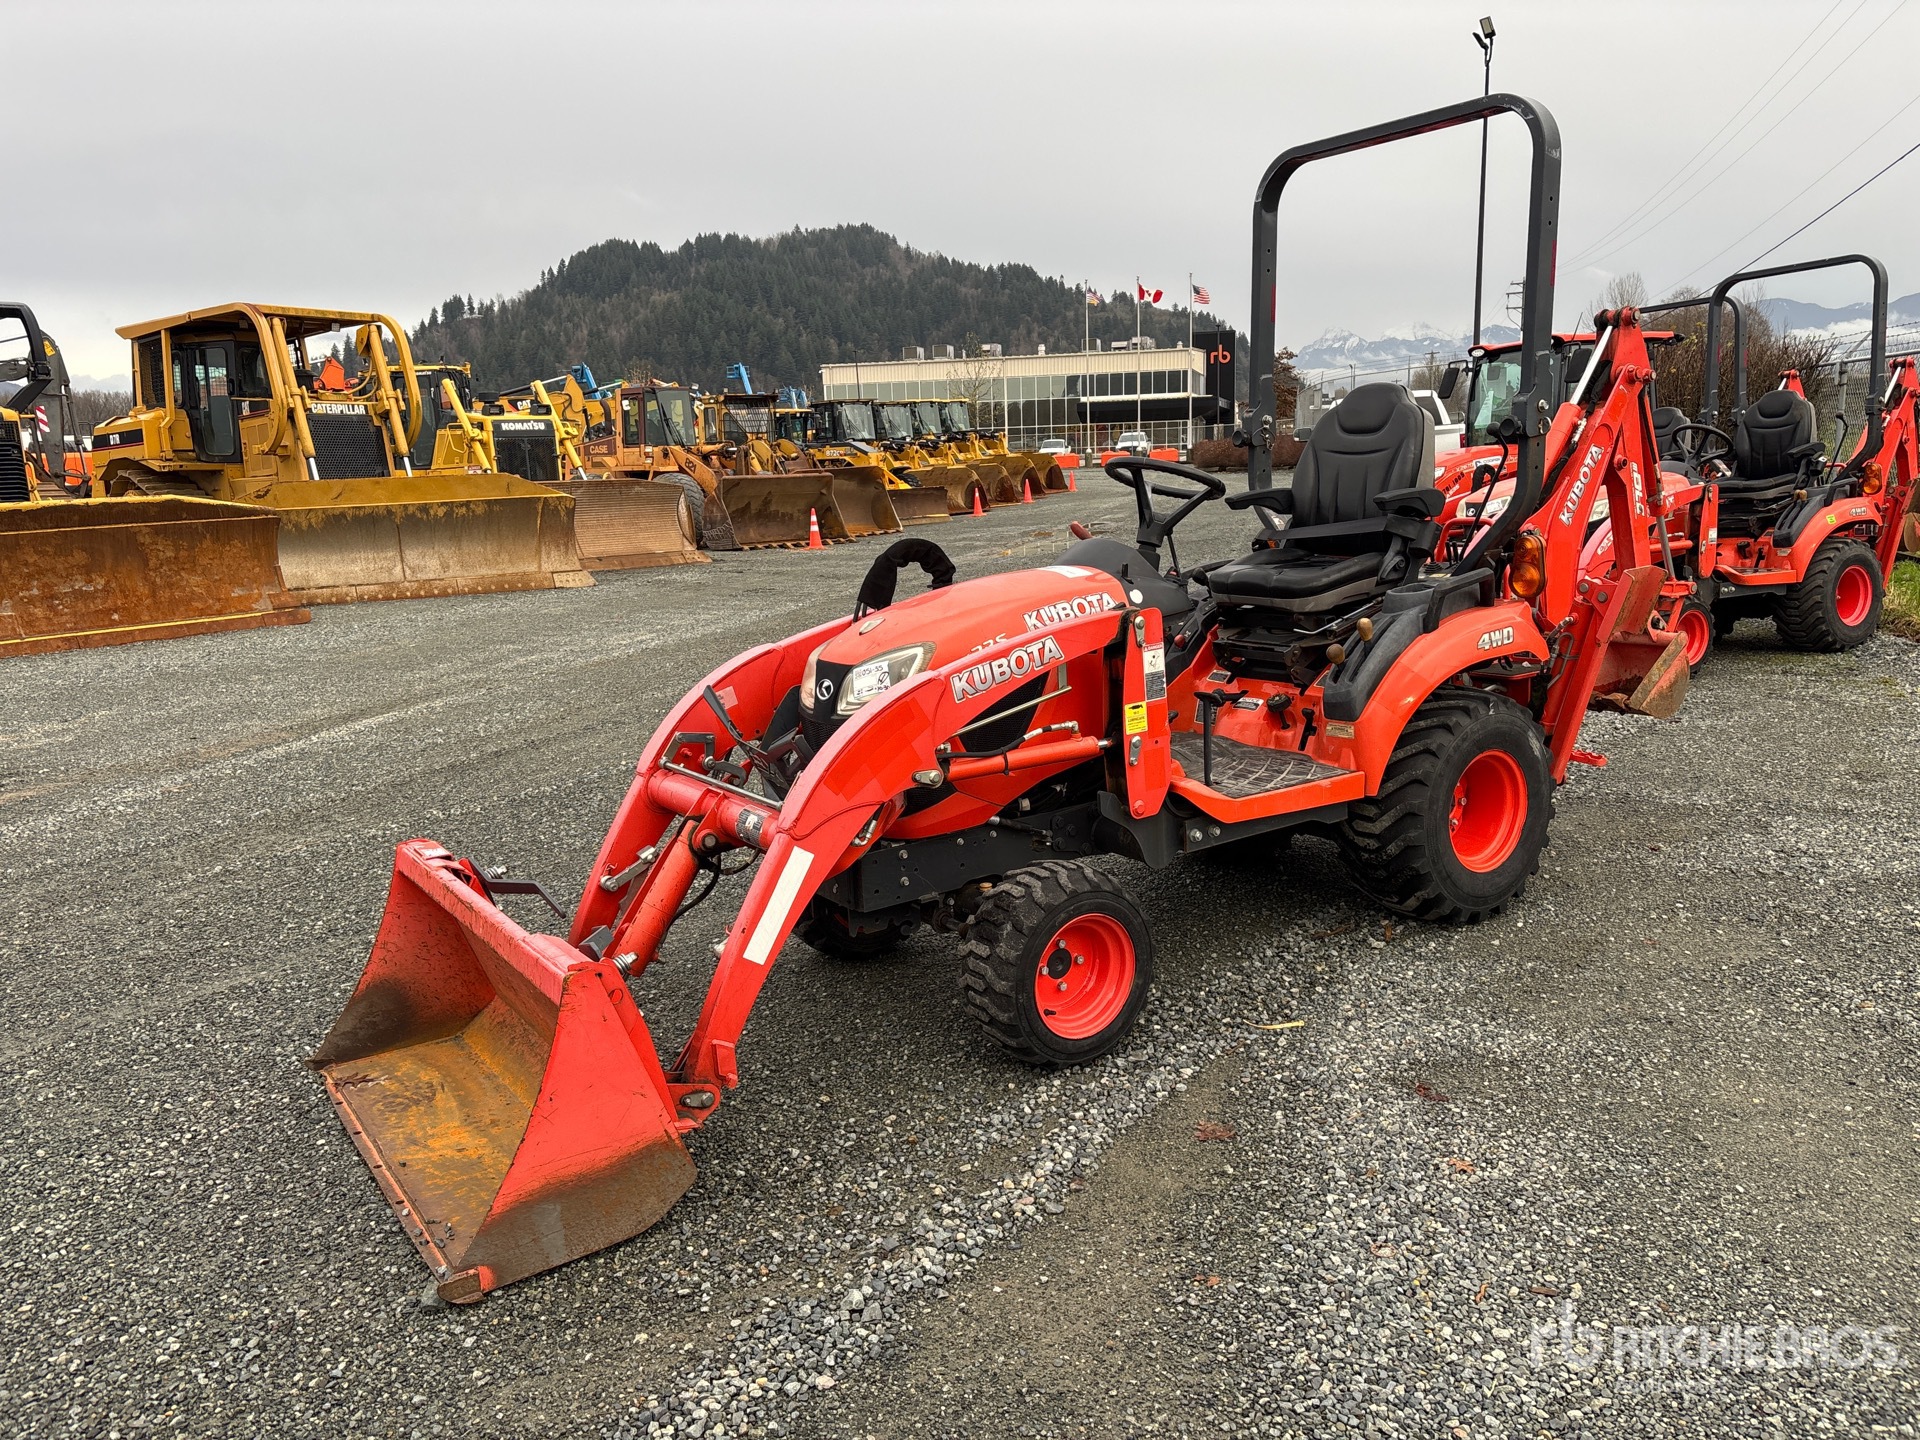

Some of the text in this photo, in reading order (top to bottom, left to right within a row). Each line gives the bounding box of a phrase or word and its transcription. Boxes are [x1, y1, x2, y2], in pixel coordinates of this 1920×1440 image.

[1210, 344, 1231, 364] rb
[311, 403, 366, 415] CATERPILLAR
[516, 400, 531, 411] CAT
[501, 421, 546, 431] KOMATSU
[109, 434, 121, 446] D7R
[589, 445, 609, 454] CASE
[1559, 443, 1605, 527] KUBOTA
[1023, 591, 1119, 632] KUBOTA
[1476, 626, 1514, 651] 4WD
[951, 636, 1064, 702] KUBOTA
